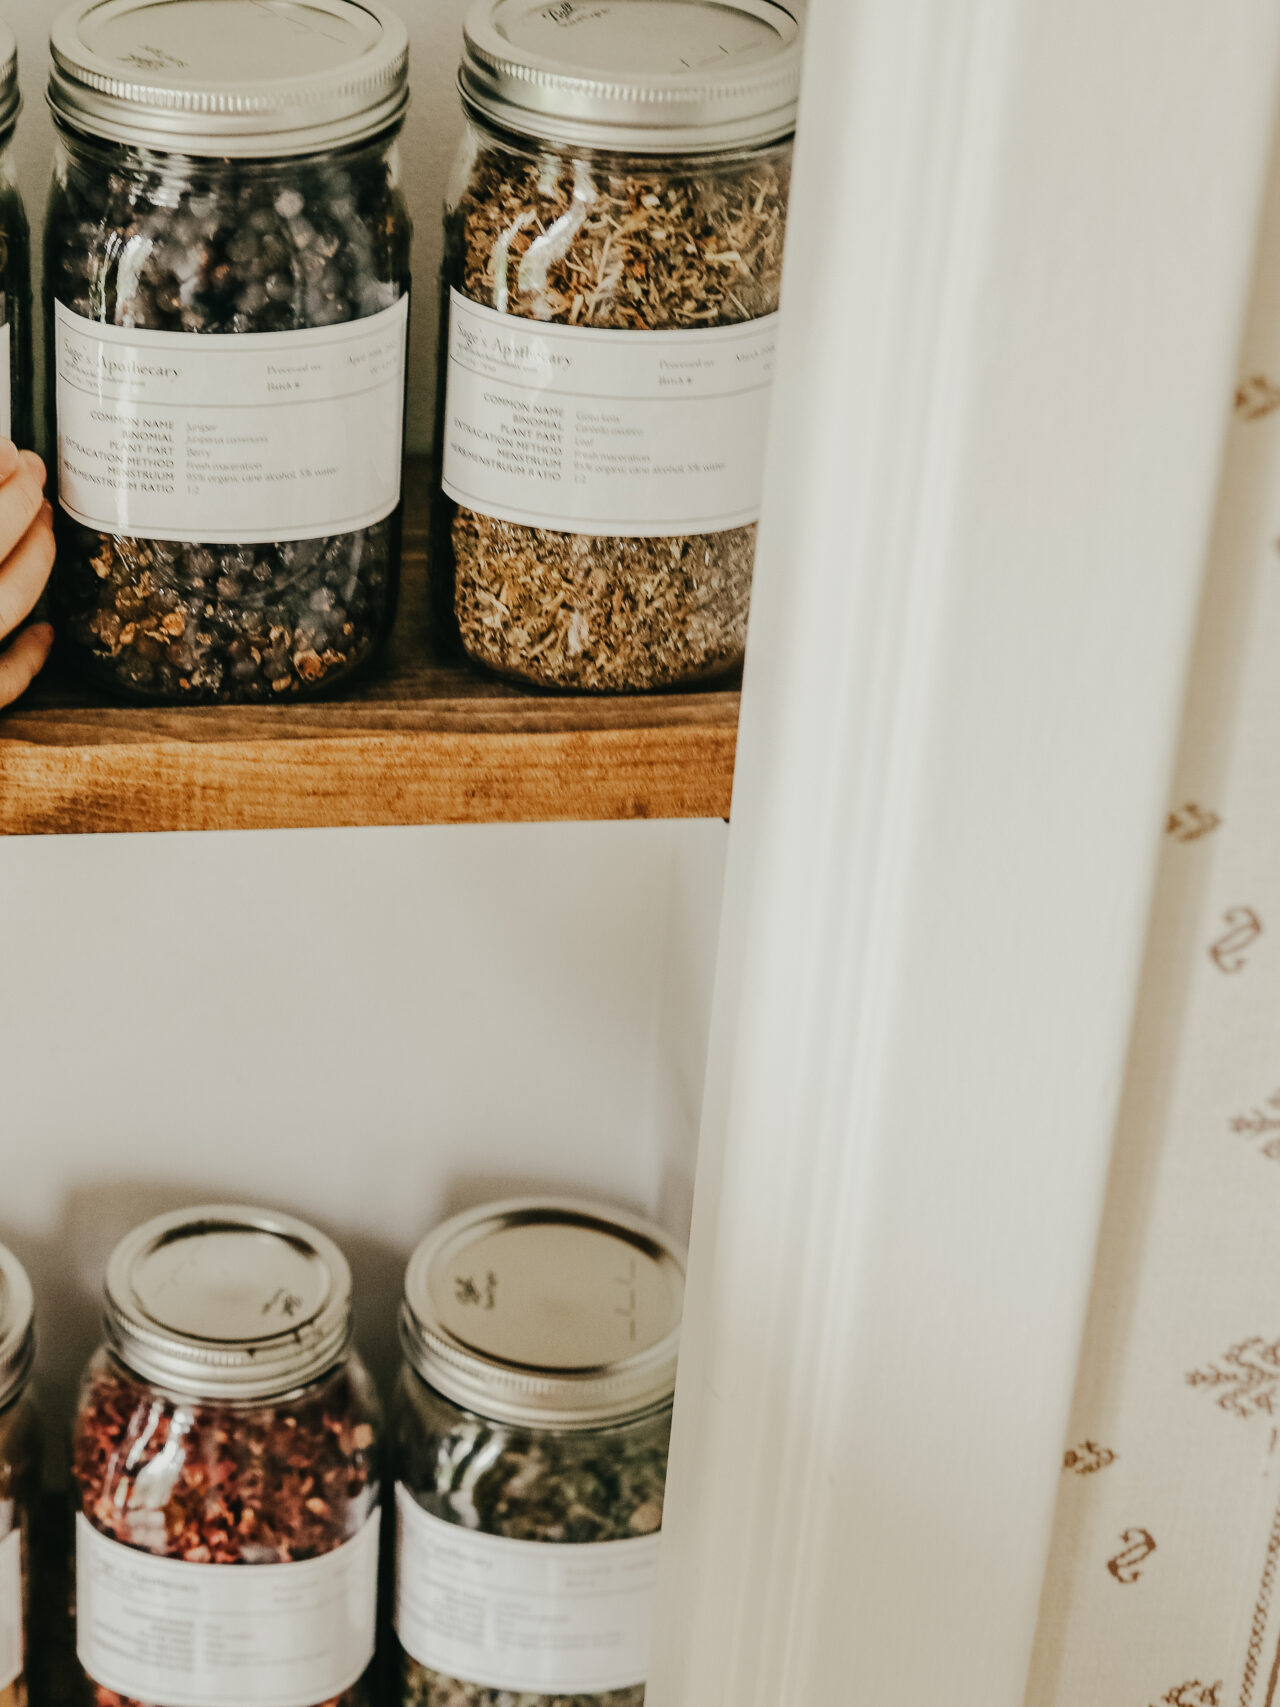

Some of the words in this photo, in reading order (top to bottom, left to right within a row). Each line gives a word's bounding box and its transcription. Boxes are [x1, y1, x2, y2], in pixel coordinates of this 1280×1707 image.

[493, 337, 573, 372] Apothecary
[100, 354, 182, 383] Apothecary
[267, 382, 293, 392] Batch
[482, 391, 530, 413] COMMON
[533, 405, 563, 417] NAME
[90, 408, 140, 428] COMMON
[142, 418, 174, 431] NAME
[512, 413, 562, 431] BINOMIAL
[120, 430, 174, 443] BINOMIAL
[500, 423, 531, 438] PLANT
[536, 431, 562, 443] PART
[109, 440, 142, 454] PLANT
[147, 445, 174, 457] PART
[516, 440, 562, 456] METHOD
[126, 456, 175, 470] METHOD
[497, 448, 562, 469] MENSTRUUM
[107, 465, 174, 482] MENSTRUUM
[528, 468, 562, 482] RATIO
[140, 481, 175, 494] RATIO
